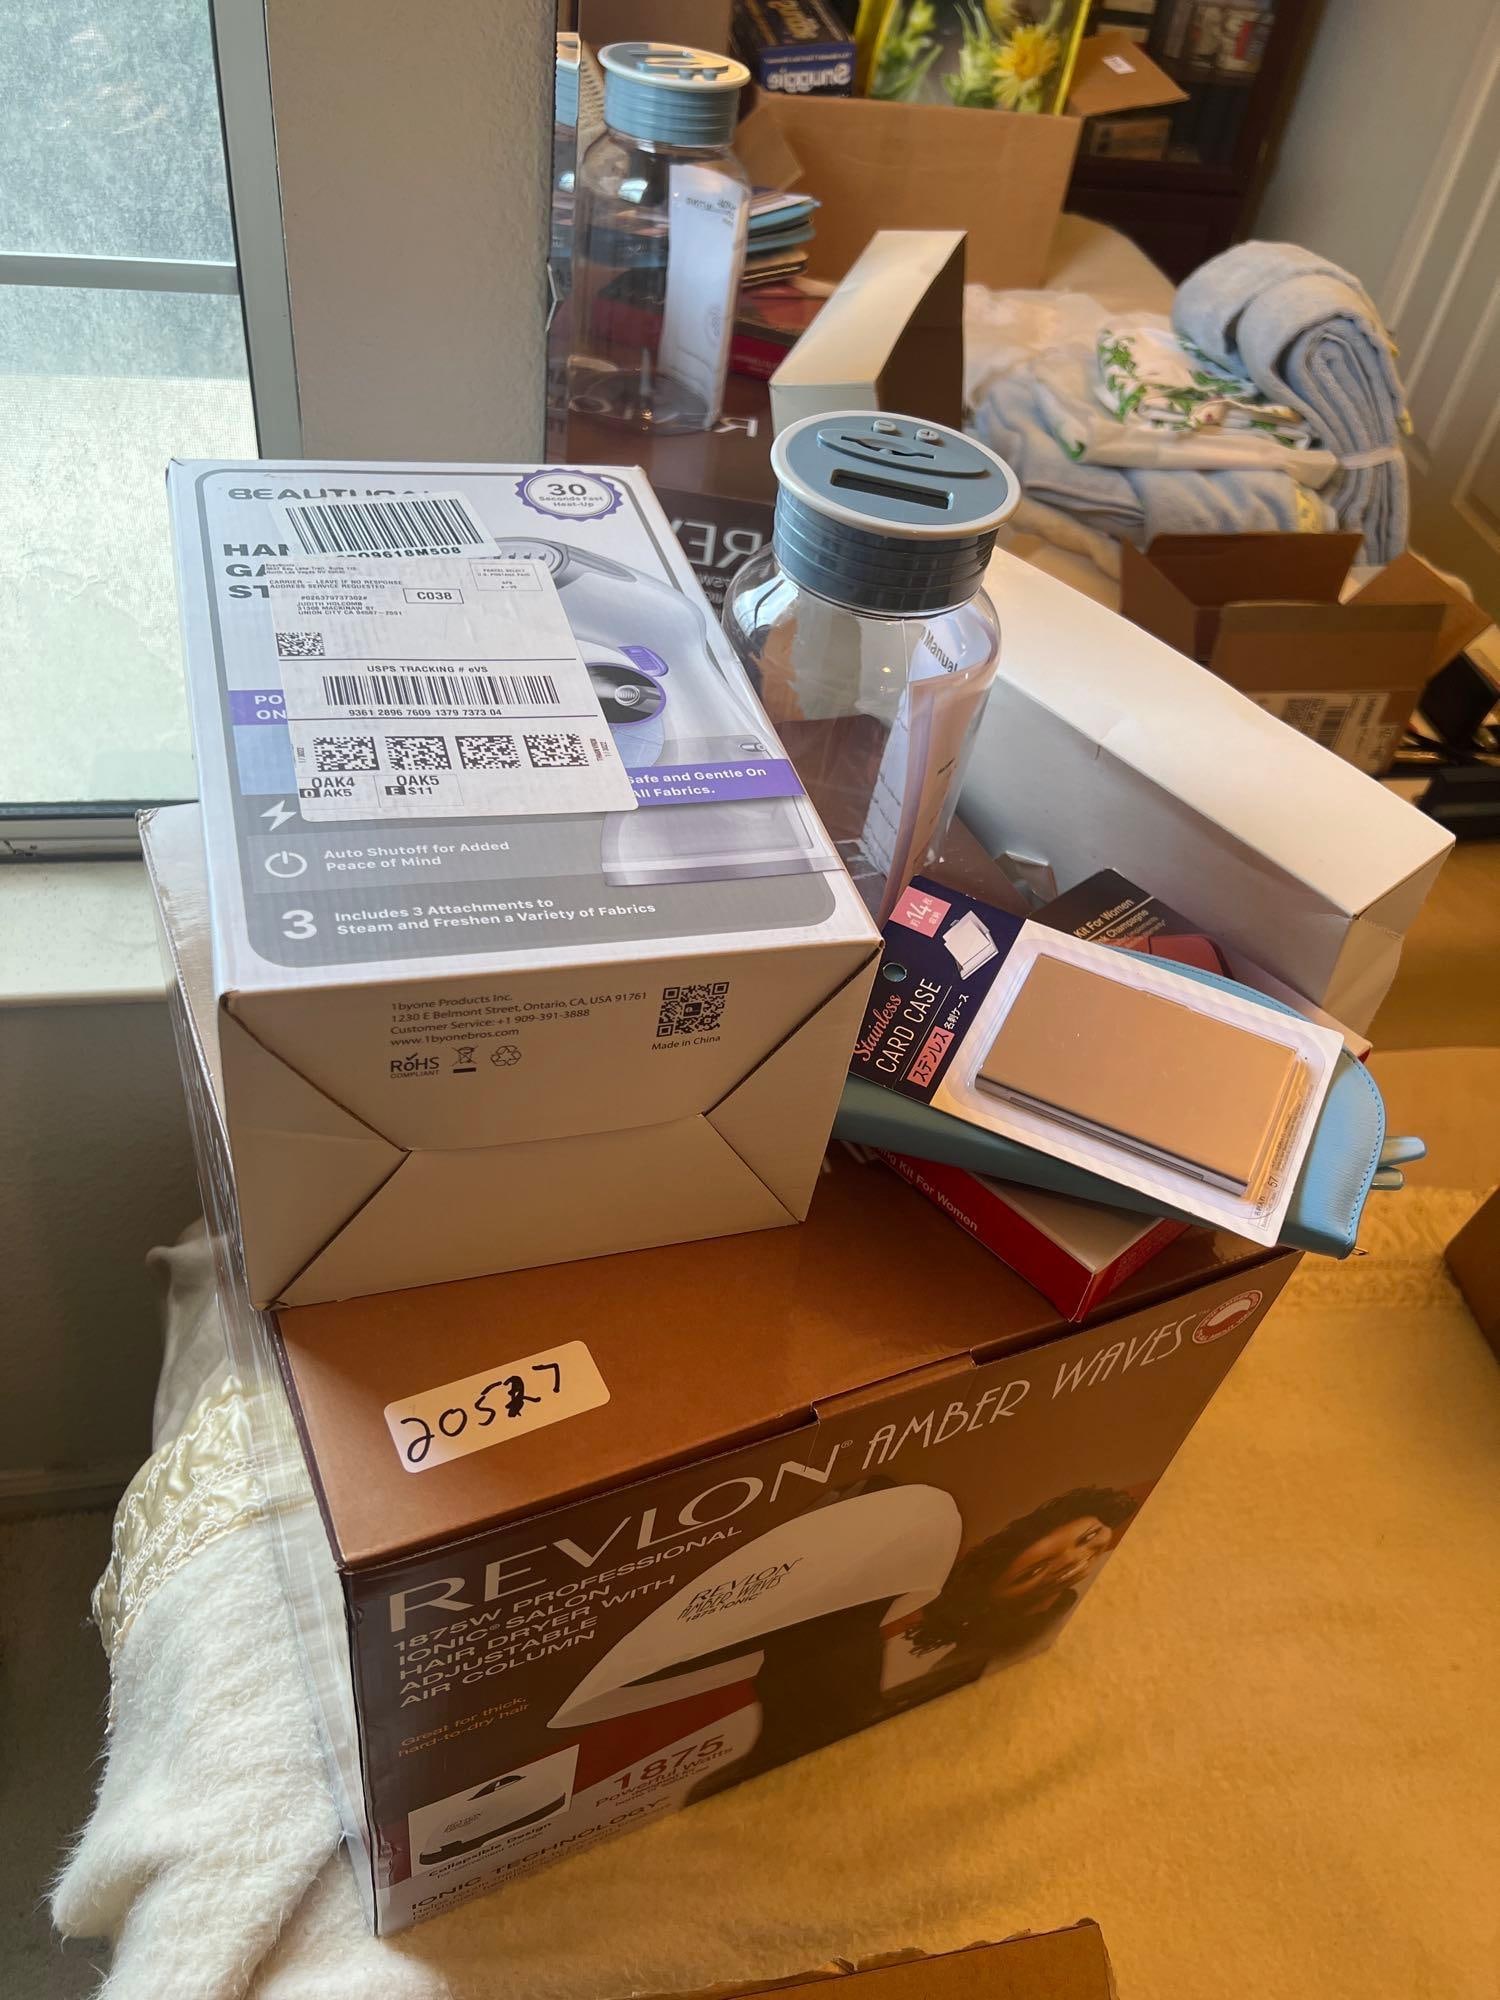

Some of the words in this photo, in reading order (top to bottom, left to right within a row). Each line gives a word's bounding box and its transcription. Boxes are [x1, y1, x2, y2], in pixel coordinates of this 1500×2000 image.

[547, 484, 588, 496] 30
[416, 591, 452, 601] C038
[367, 665, 398, 674] USPS
[400, 665, 455, 674] TRACKING
[468, 665, 489, 673] eVS
[349, 709, 374, 717] 9361
[407, 709, 432, 717] 7609
[436, 708, 459, 717] 1379
[462, 708, 487, 716] 7373
[490, 708, 502, 716] 04
[311, 777, 356, 788] OAK4
[396, 775, 440, 786] OAK5
[653, 784, 716, 797] Fabrics.
[663, 772, 691, 782] and
[694, 768, 743, 780] Gentle
[746, 768, 767, 777] On
[324, 848, 363, 859] Auto
[367, 844, 432, 858] Shutoff
[432, 843, 455, 854] for
[459, 841, 510, 853] Added
[326, 859, 374, 872] Peace
[376, 858, 397, 869] of
[401, 855, 442, 867] Mind
[281, 909, 318, 940] 3
[334, 906, 409, 922] Includes
[412, 906, 424, 917] 3
[427, 899, 534, 916] Attachments
[537, 898, 554, 908] to
[337, 921, 396, 936] Steam
[397, 918, 429, 930] and
[434, 913, 501, 928] Freshen
[504, 914, 514, 923] a
[518, 908, 575, 925] Variety
[578, 907, 596, 918] of
[598, 903, 656, 917] Fabrics
[1073, 922, 1090, 939] Kit
[1088, 917, 1104, 932] For
[1101, 898, 1135, 921] Women
[1105, 909, 1149, 938] Champagne
[391, 1012, 421, 1023] 1230
[423, 1010, 431, 1020] E
[433, 1007, 480, 1019] Belmont
[482, 1004, 522, 1016] Street,
[523, 1000, 568, 1012] Ontario,
[590, 995, 612, 1005] USA
[615, 991, 648, 1001] 91761
[392, 998, 437, 1011] 1byone
[438, 994, 491, 1008] Products
[493, 992, 513, 1002] Inc.
[390, 1023, 449, 1036] Customer
[450, 1018, 495, 1030] Service:
[514, 1008, 590, 1024] 909-391-3888
[391, 1028, 520, 1047] www.1byonebros.com
[854, 992, 903, 1062] Stainless
[876, 1025, 916, 1073] CARD
[903, 978, 942, 1023] CASE
[652, 1041, 682, 1051] Made
[693, 1034, 721, 1045] China
[913, 1031, 950, 1082] ステンレス
[390, 1070, 440, 1079] COMPLIANT
[391, 1057, 440, 1073] RoHS
[899, 1160, 914, 1179] Kit
[916, 1174, 935, 1195] For
[937, 1191, 978, 1231] Women
[862, 1380, 1031, 1470] AMBER
[1052, 1314, 1197, 1399] WAVES
[394, 1608, 502, 1650] 1875W
[512, 1527, 743, 1614] PROFESSIONAL
[690, 1557, 804, 1604] REVLON
[505, 1586, 611, 1628] SALON
[400, 1642, 479, 1680] HAIR
[487, 1605, 592, 1653] DRYER
[601, 1574, 677, 1610] WITH
[398, 1616, 599, 1694] ADJUSTABLE
[398, 1682, 451, 1708] AIR
[461, 1630, 596, 1687] COLUMN
[398, 1717, 494, 1758] hard-to-dry
[494, 1703, 530, 1724] hair
[401, 1722, 448, 1748] Great
[454, 1712, 479, 1730] for
[613, 1733, 727, 1792] 1875
[411, 1877, 481, 1911] IONIC
[492, 1796, 670, 1876] TECHNOLOGY
